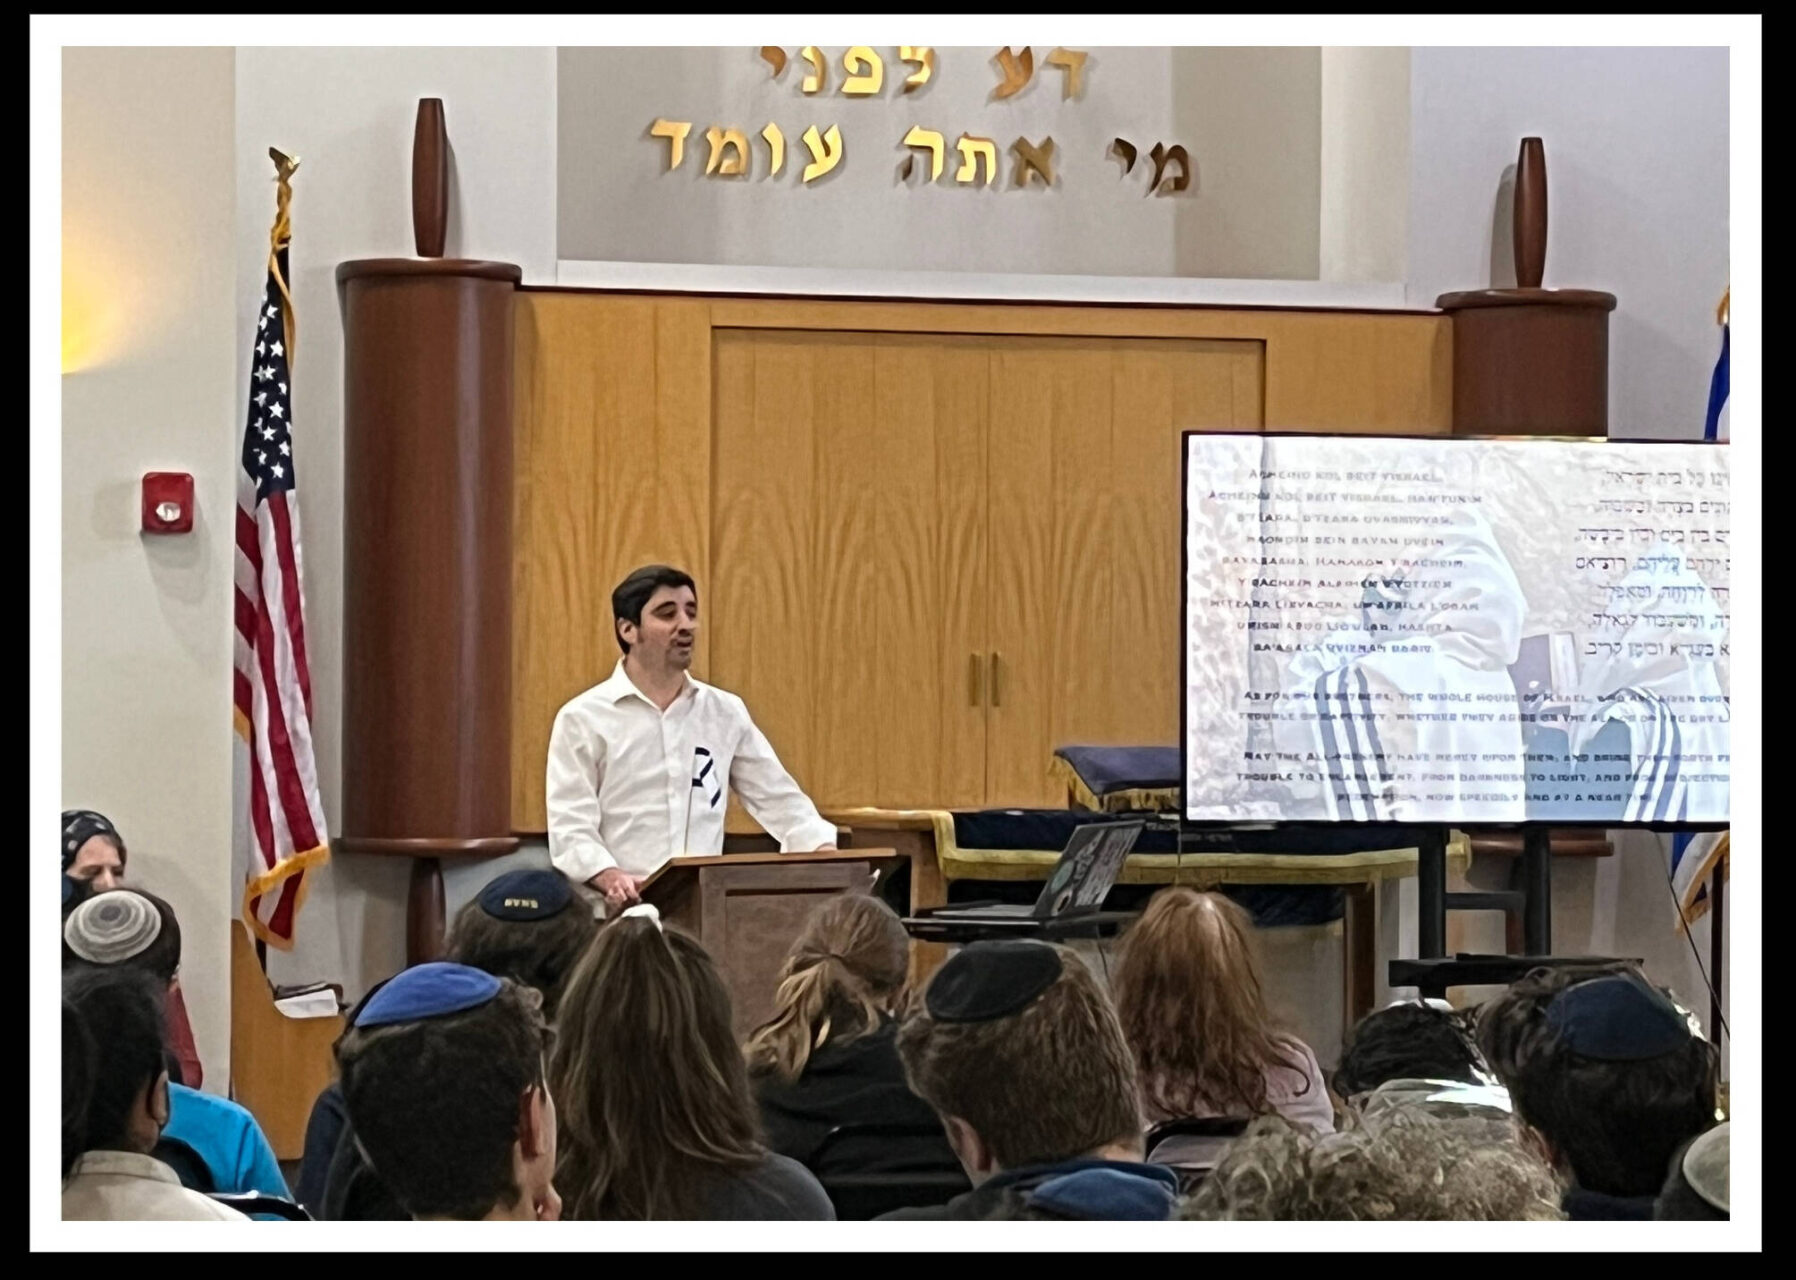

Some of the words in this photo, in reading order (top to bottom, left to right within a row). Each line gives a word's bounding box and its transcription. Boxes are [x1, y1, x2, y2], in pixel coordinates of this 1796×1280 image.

[992, 46, 1089, 101] דע
[650, 118, 845, 184] עומד
[902, 124, 1057, 187] אתה
[1113, 136, 1192, 196] מי
